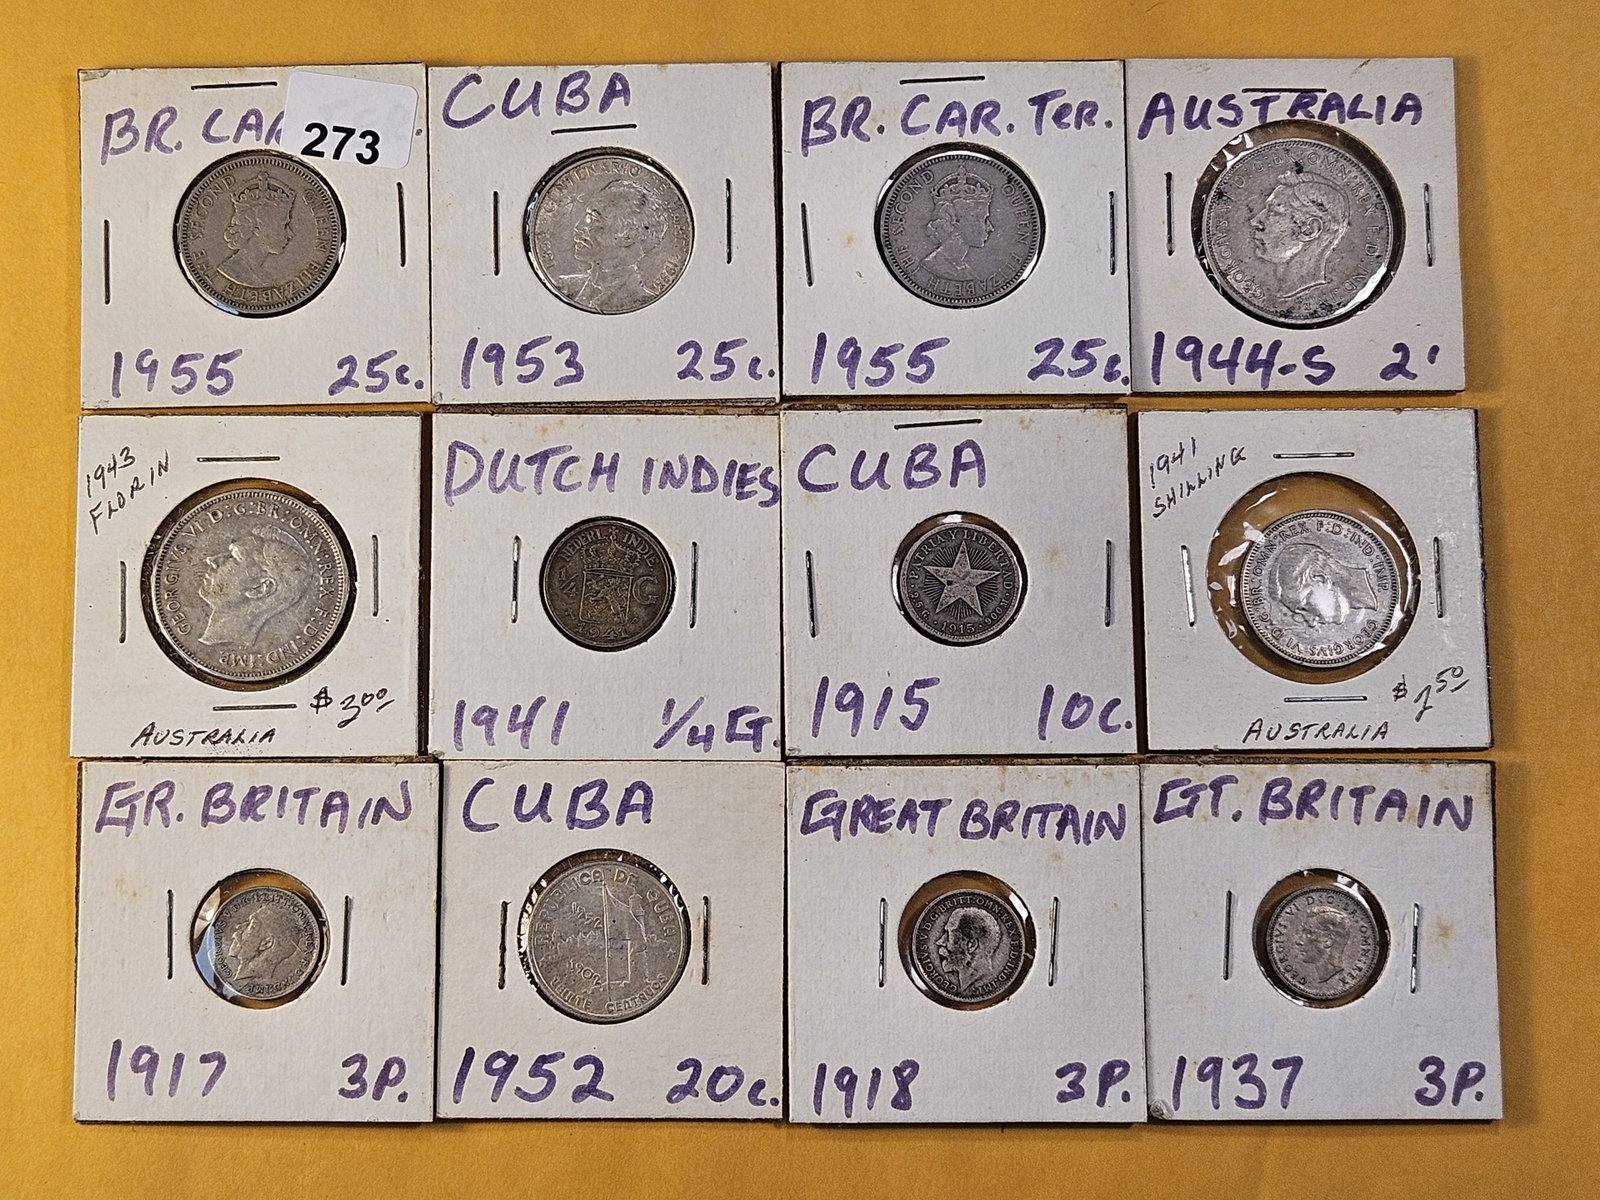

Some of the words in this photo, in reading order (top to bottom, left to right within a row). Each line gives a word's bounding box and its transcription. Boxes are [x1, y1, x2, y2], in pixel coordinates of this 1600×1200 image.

[442, 69, 632, 129] CUBA
[801, 95, 885, 157] BR.
[901, 94, 1015, 137] CAR.
[1137, 92, 1423, 140] AUSTRALIA
[101, 105, 182, 165] BR.
[299, 122, 382, 165] 273
[190, 174, 236, 240] SECOND
[892, 170, 934, 236] SECOND
[1002, 183, 1031, 246] QUEEN
[112, 349, 243, 398] 1955
[461, 336, 585, 389] 1953
[811, 331, 950, 390] 1955
[1151, 331, 1336, 390] 1944-S
[86, 446, 136, 497] 1943
[444, 440, 619, 507] DUTCH
[641, 453, 781, 508] INDIES
[797, 438, 987, 493] CUBA
[1150, 437, 1197, 489] 1941
[1152, 446, 1247, 519] SHILLING
[88, 450, 170, 534] FLORIN
[909, 533, 946, 579] PATRIA
[948, 529, 957, 540] Y
[963, 529, 1013, 590] LIBERTAD
[164, 543, 193, 635] GEORGIVS
[575, 622, 629, 640] 1941
[940, 621, 975, 634] 1915
[1286, 636, 1303, 653] VI
[1309, 618, 1378, 657] GEORGIVS
[130, 721, 277, 748] AUSTRALIA
[453, 696, 570, 752] 1941
[812, 676, 940, 738] 1915
[1242, 718, 1391, 744] AUSTRALIA
[95, 780, 184, 838] GR.
[200, 779, 413, 834] BRITAIN
[462, 777, 654, 833] CUBA
[800, 788, 953, 842] GREAT
[959, 798, 1127, 846] BRITAIN
[1153, 775, 1242, 824] GT.
[1259, 776, 1474, 832] BRITAIN
[534, 868, 605, 947] REPUBLICA
[614, 868, 638, 886] DE
[919, 933, 929, 941] V
[1274, 921, 1307, 985] GEORGIVS
[568, 958, 602, 986] 1902
[920, 944, 957, 992] GEORGIVS
[107, 1038, 227, 1102] 1917
[338, 1053, 409, 1104] 3P.
[452, 1046, 615, 1105] 1952
[814, 1058, 920, 1118] 1918
[1055, 1058, 1131, 1108] 3P.
[1172, 1052, 1304, 1111] 1937
[1414, 1055, 1486, 1107] 3P.
